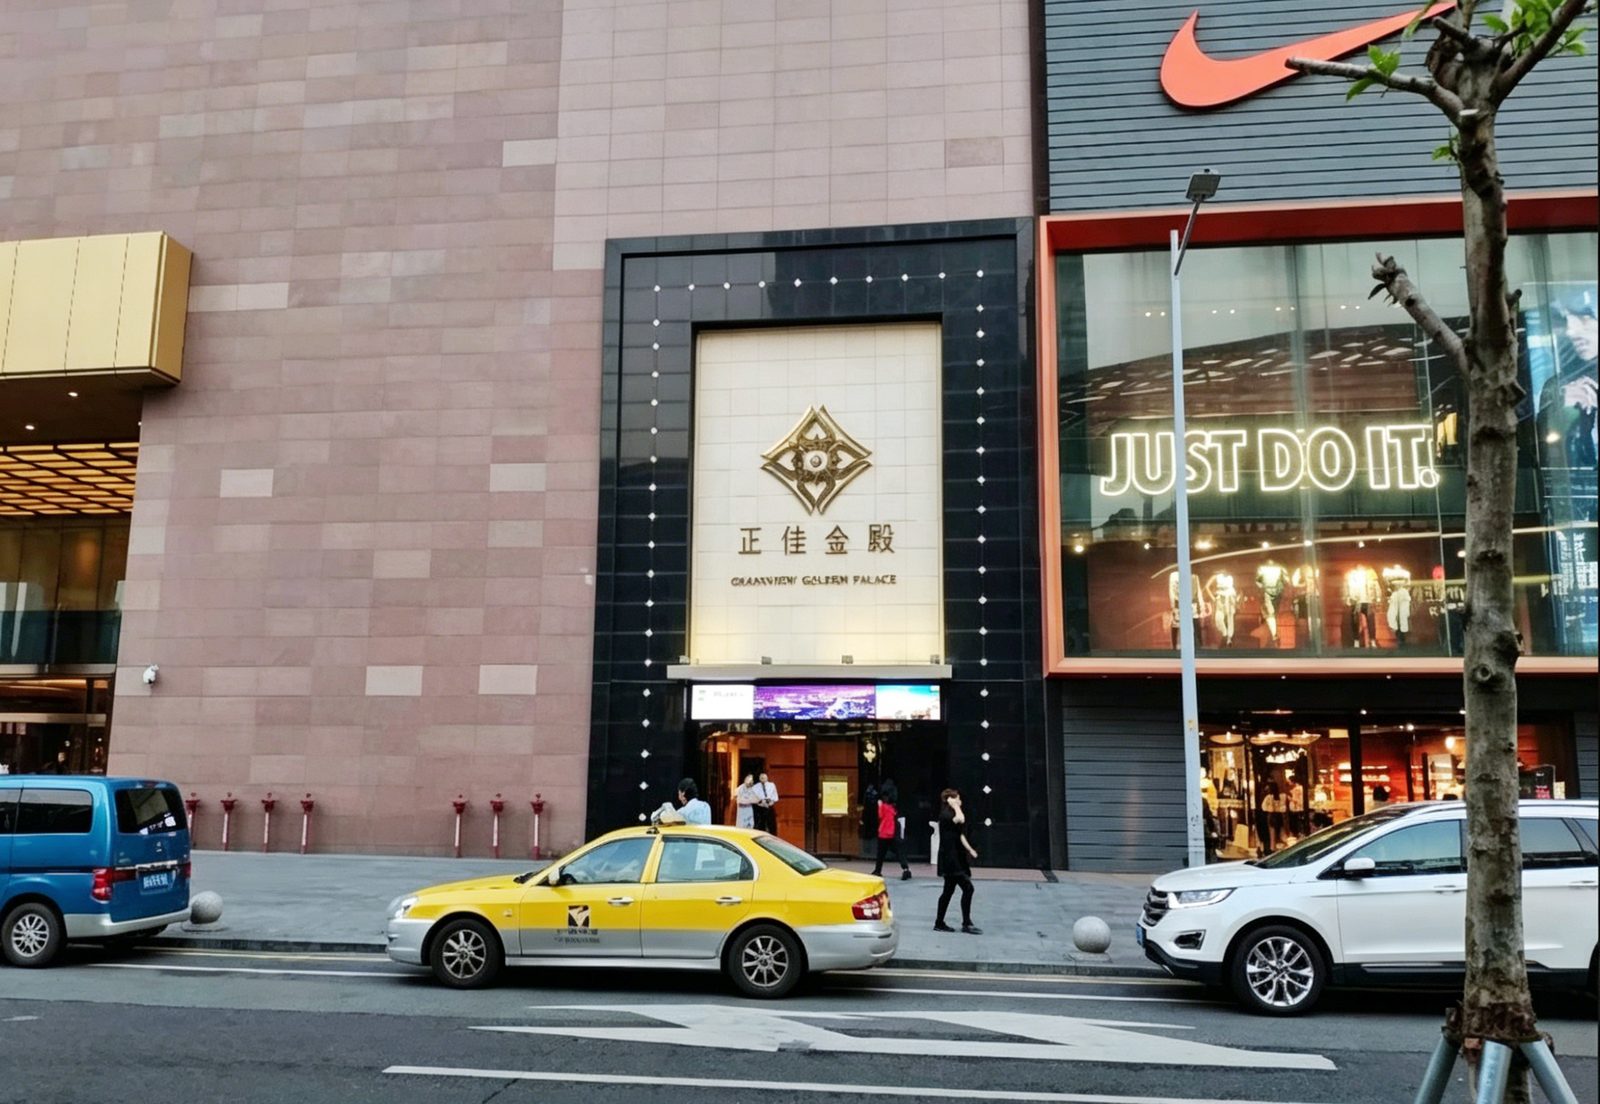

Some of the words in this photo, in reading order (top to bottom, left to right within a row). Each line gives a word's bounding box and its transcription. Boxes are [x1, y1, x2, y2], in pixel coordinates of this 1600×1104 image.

[1100, 429, 1247, 496] JUST
[1258, 427, 1357, 492] DO
[738, 524, 895, 556] 正佳金殿
[852, 574, 897, 585] PALACE
